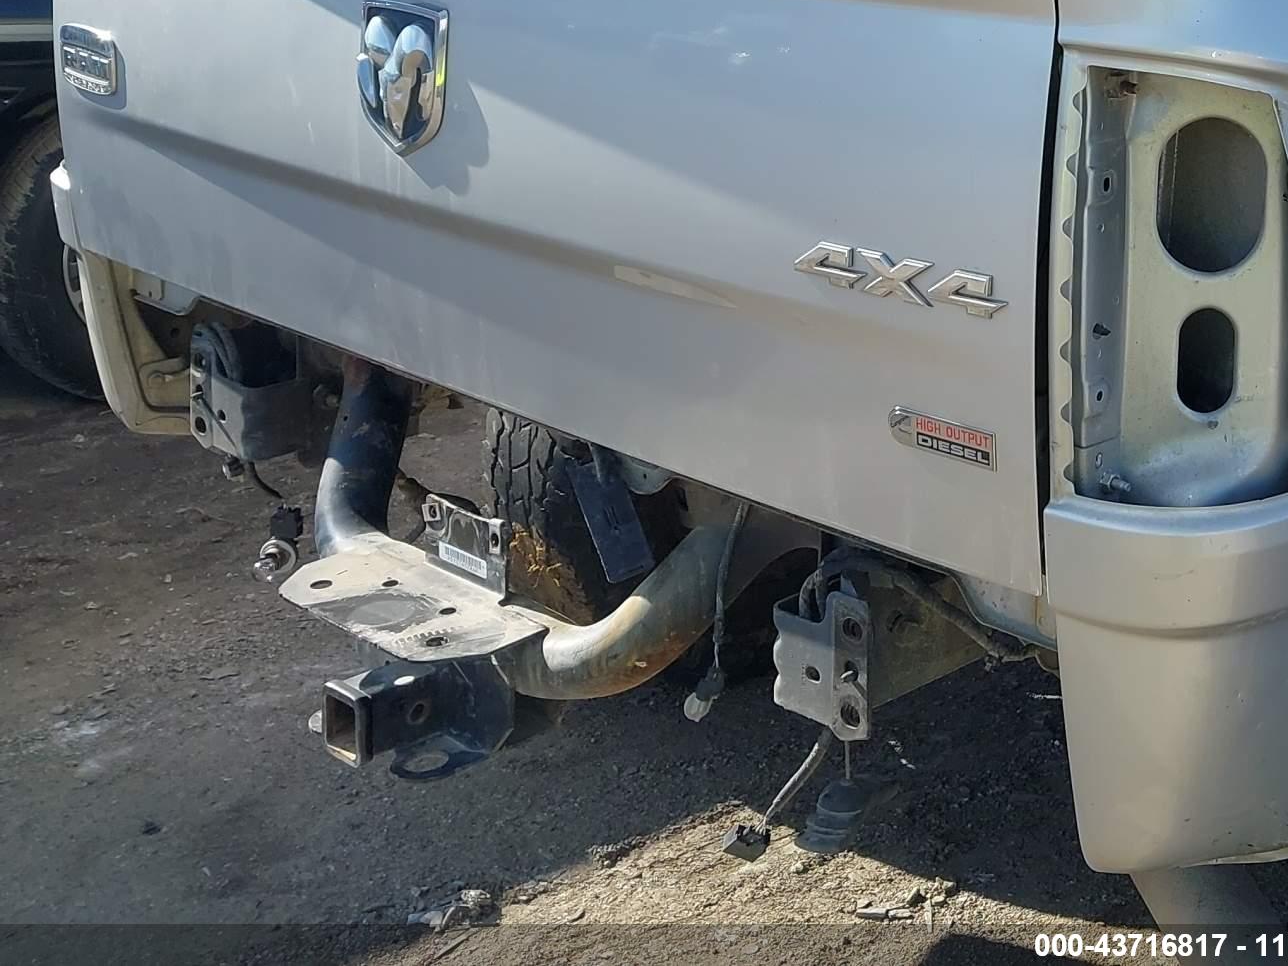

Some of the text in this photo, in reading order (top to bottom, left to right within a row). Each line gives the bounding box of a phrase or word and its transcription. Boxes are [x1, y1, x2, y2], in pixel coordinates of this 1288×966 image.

[915, 417, 990, 448] HIGH OUTPUT
[917, 435, 990, 464] DIESEL
